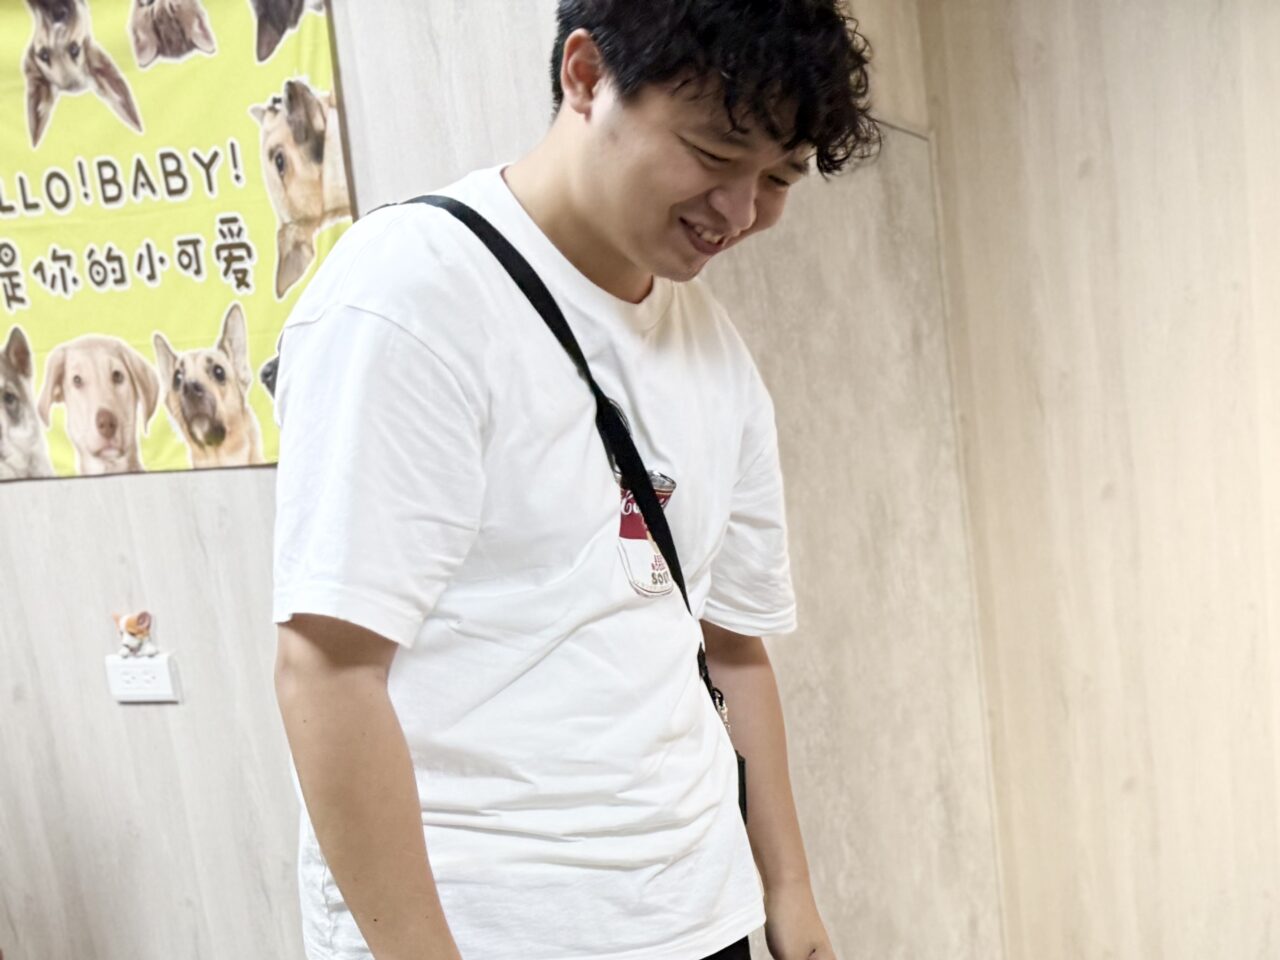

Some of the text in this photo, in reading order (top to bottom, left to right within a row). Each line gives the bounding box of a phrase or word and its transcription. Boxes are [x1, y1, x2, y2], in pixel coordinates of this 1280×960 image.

[0, 217, 253, 309] 是你的小可爱
